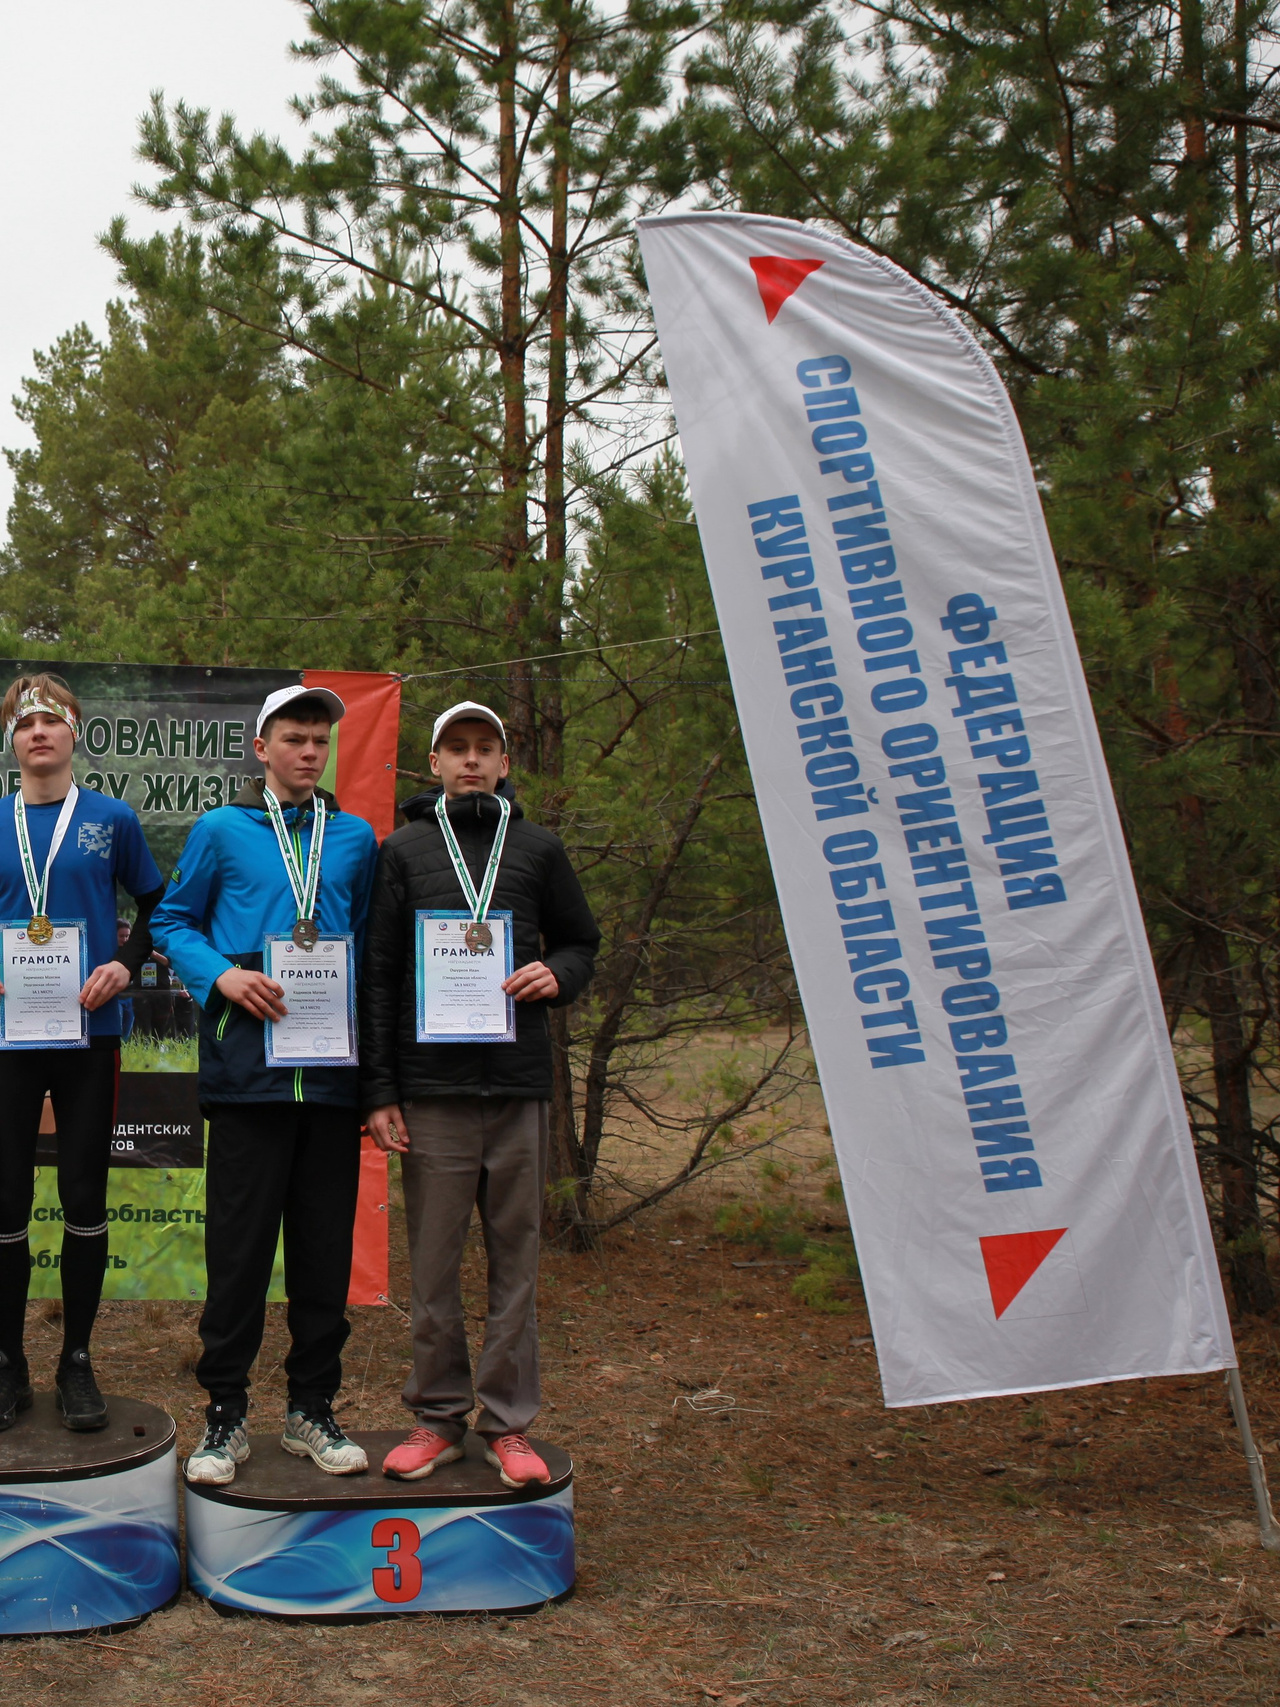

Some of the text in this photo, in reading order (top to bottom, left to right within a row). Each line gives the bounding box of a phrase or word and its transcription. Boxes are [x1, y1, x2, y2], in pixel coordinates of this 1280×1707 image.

[940, 592, 1067, 910] ФЕДЕРАЦИЯ
[141, 773, 265, 813] ЖИЗН
[747, 494, 926, 1069] КУРГАНСКОЙ ОБЛАСТИ
[796, 354, 1043, 1193] СПОРТИВНОГО ОРИЕНТИРОВАНИЯ
[12, 955, 71, 965] ГРАМОТА
[280, 970, 338, 979] ГРАМОТА
[112, 1124, 191, 1136] ДЕНТСКИХ
[107, 1204, 207, 1223] область
[371, 1516, 423, 1605] 3
